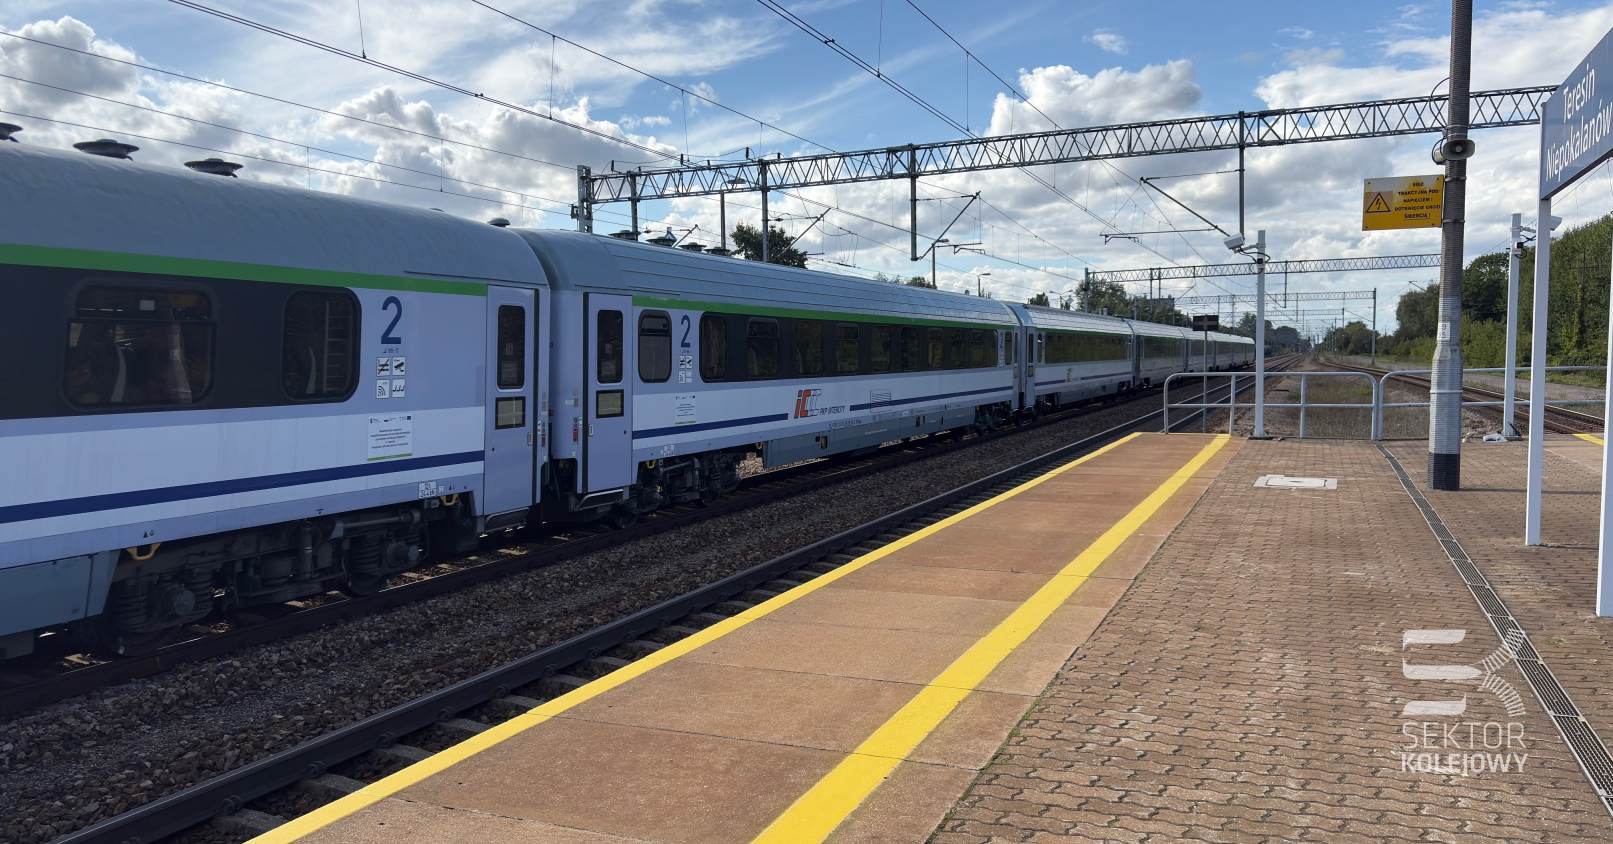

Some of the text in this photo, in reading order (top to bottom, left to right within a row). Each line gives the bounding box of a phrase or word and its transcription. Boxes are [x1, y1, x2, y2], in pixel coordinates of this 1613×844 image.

[1563, 63, 1595, 124] Teresin
[1546, 99, 1613, 182] Niepokalanów
[381, 296, 402, 344] 2
[681, 315, 691, 348] 2
